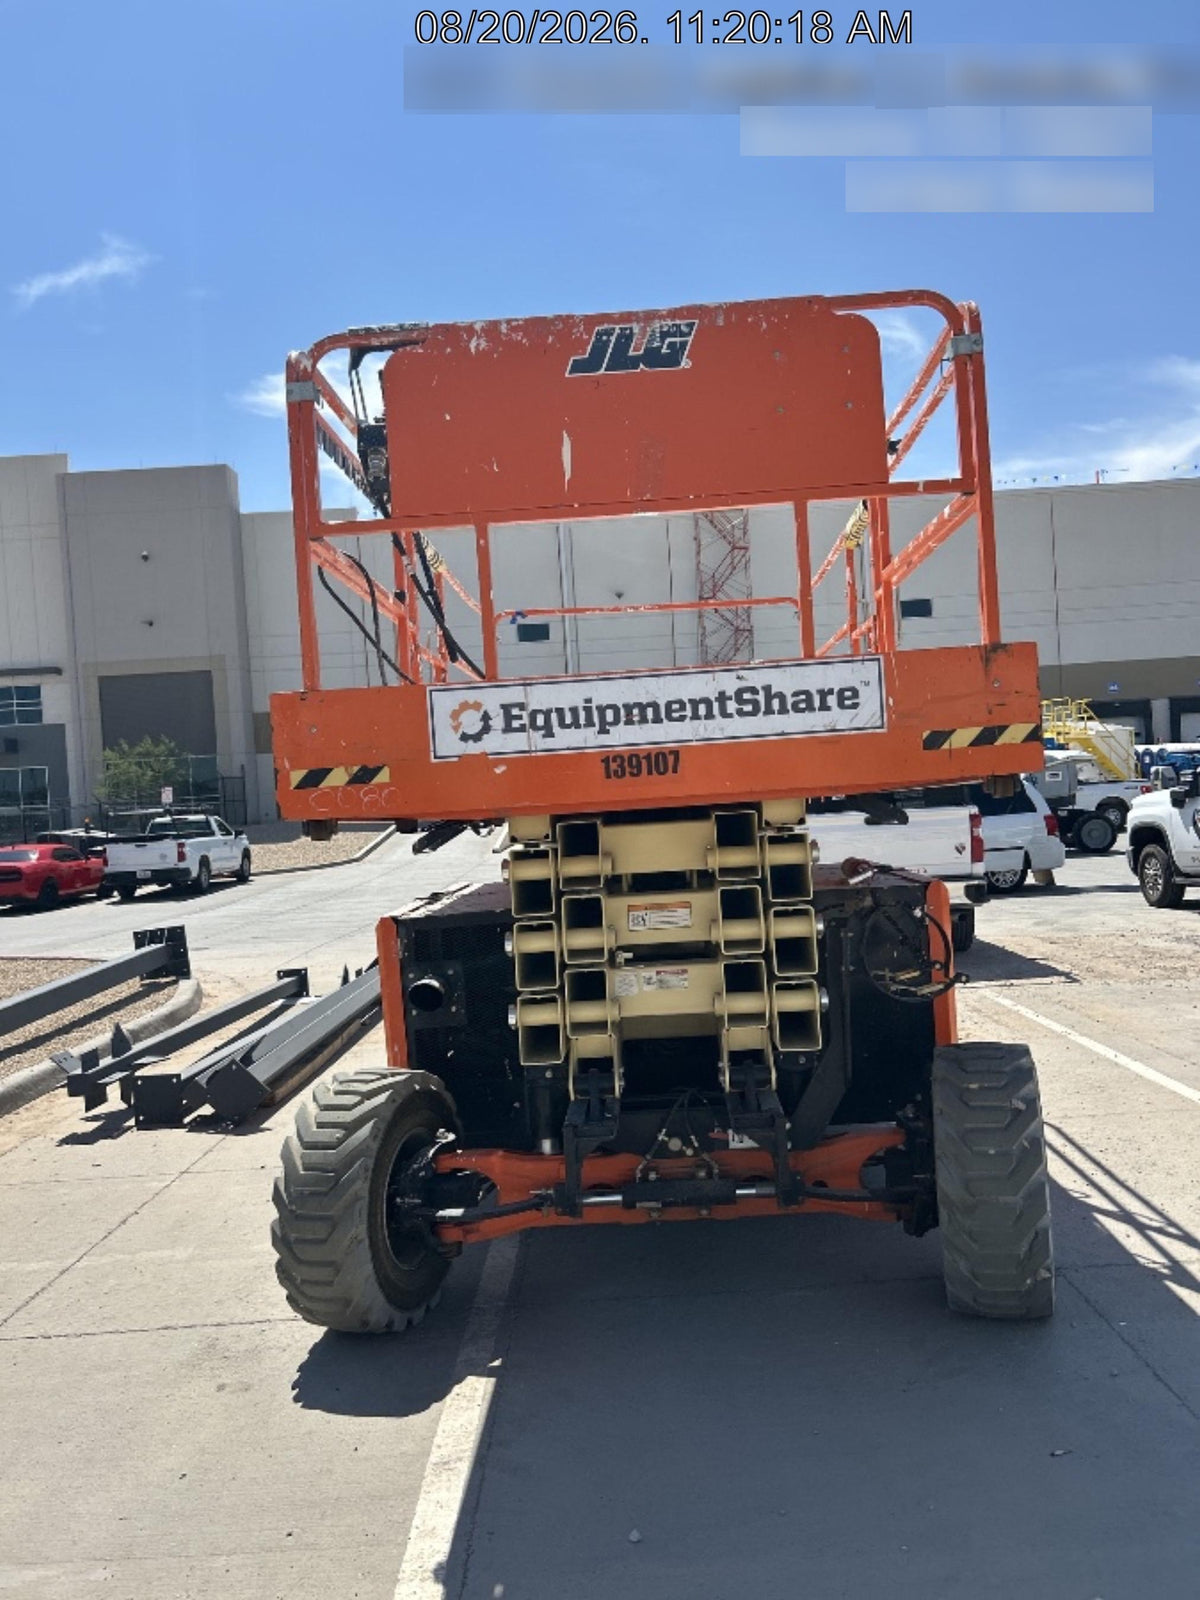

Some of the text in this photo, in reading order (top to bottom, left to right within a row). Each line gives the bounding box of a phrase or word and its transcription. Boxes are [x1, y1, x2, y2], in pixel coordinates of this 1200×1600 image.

[565, 320, 699, 377] JLG
[499, 684, 860, 738] EquipmentShare
[601, 750, 680, 780] 139107
